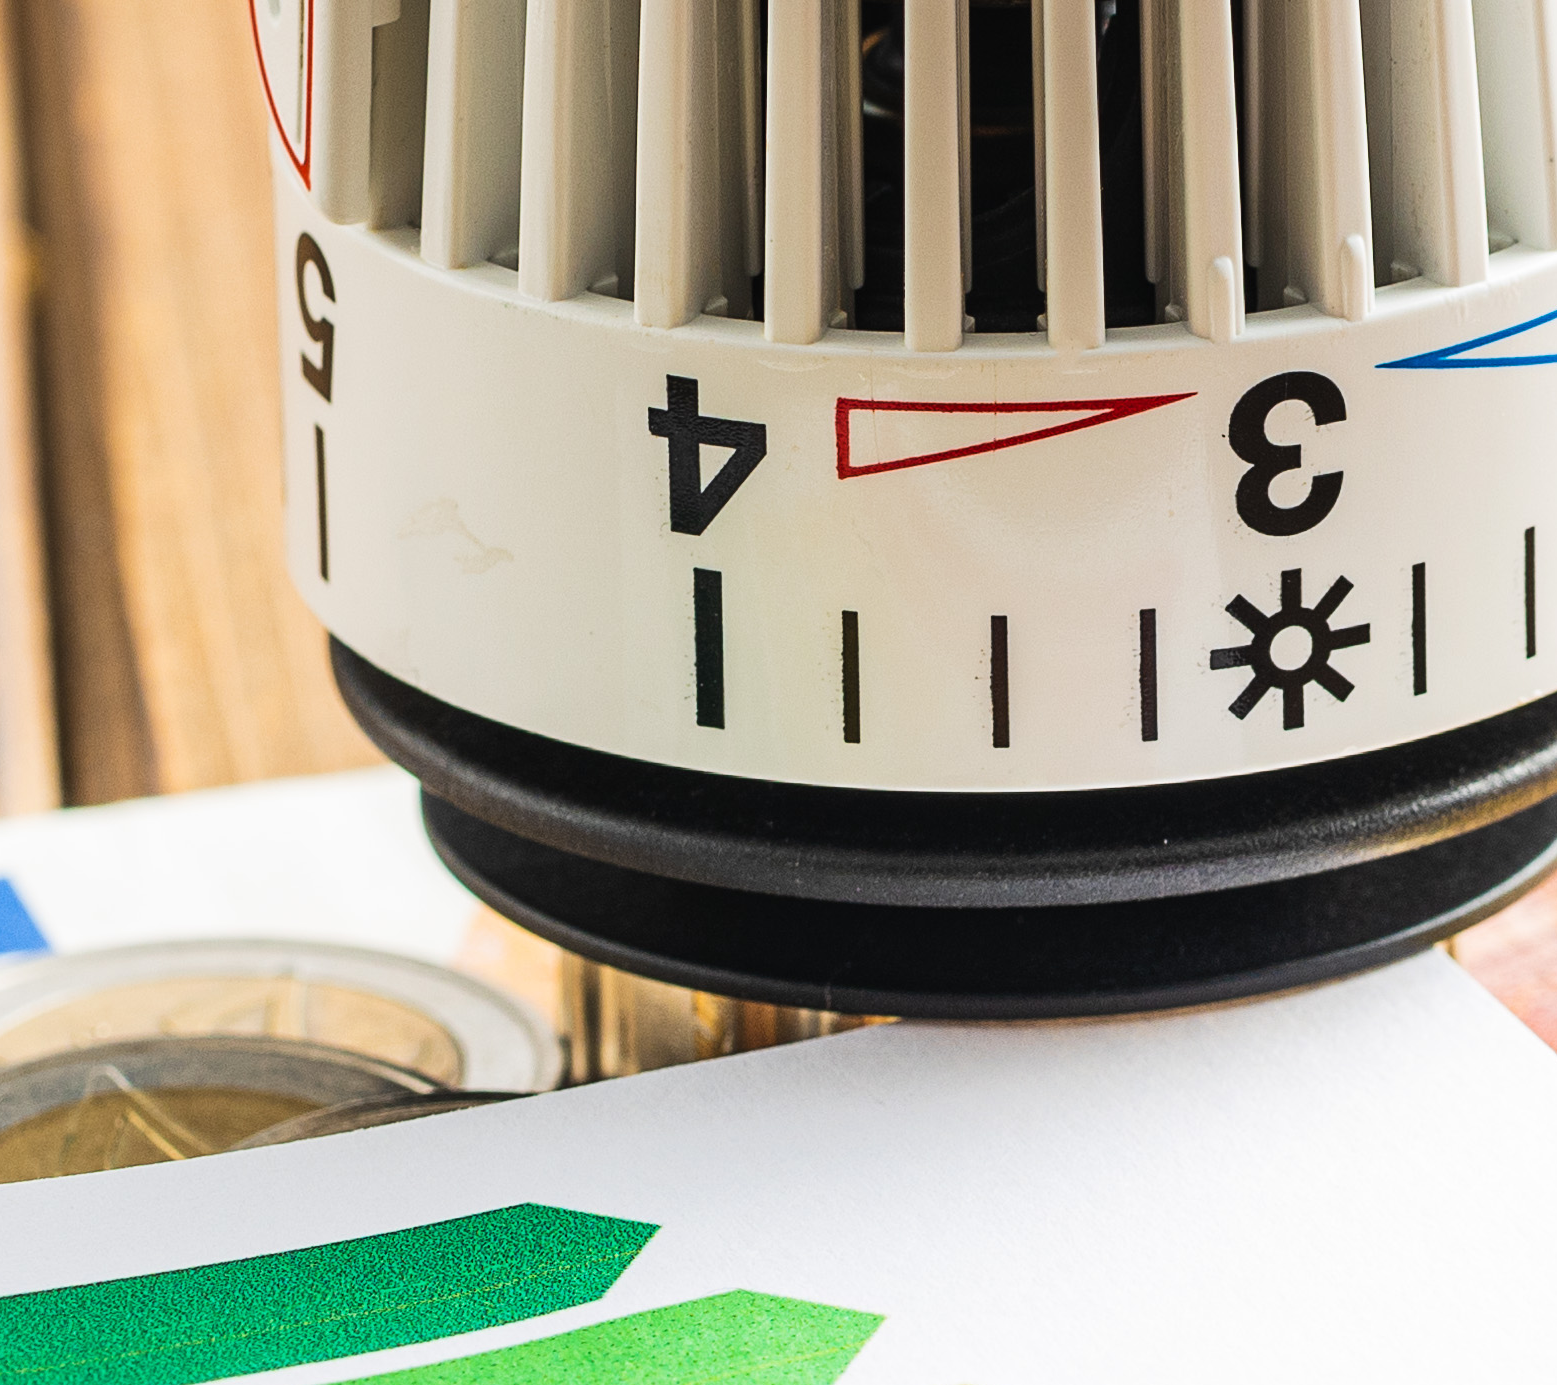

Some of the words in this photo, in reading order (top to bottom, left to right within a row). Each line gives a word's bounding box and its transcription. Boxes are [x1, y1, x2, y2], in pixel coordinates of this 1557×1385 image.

[295, 232, 336, 405] 5
[648, 375, 768, 536] 4
[1228, 371, 1347, 537] 3
